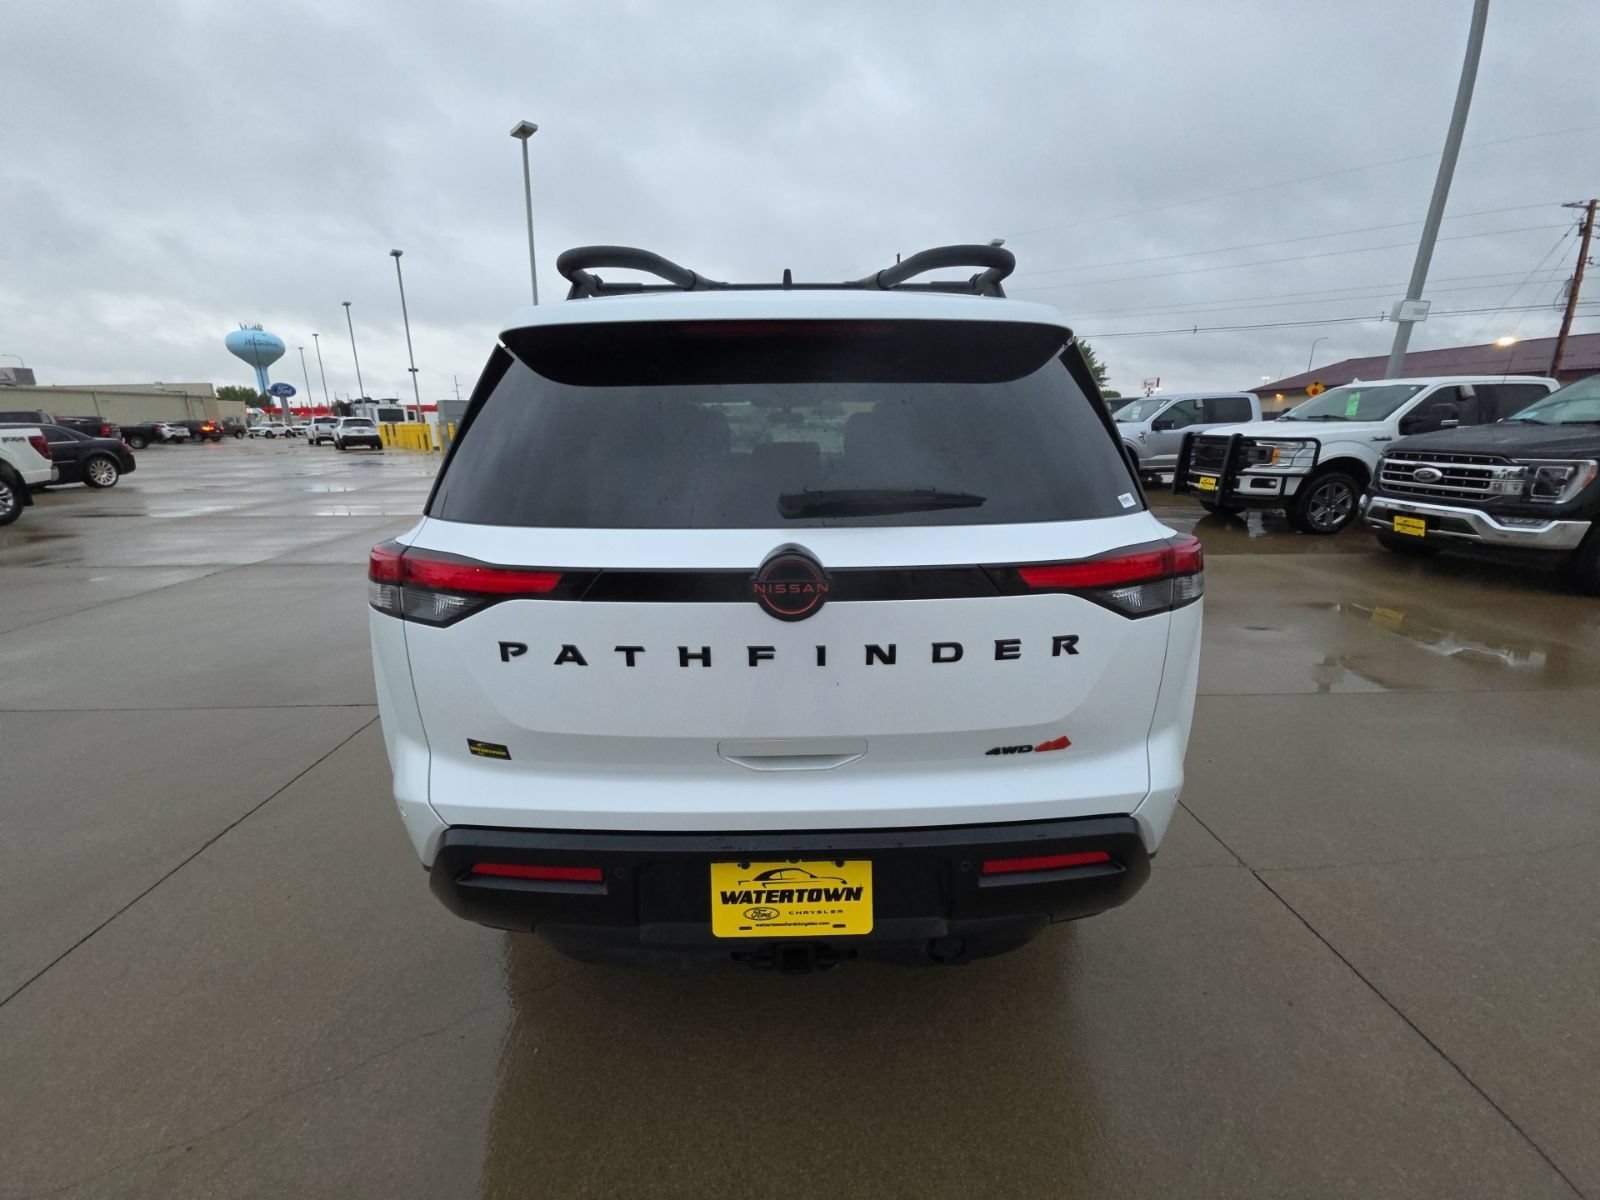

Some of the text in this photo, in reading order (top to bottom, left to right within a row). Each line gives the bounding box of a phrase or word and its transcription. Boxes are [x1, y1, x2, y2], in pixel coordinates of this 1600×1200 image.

[753, 582, 829, 594] NISSAN
[498, 634, 1080, 667] PATHFINDER
[985, 744, 1033, 756] 4WD
[720, 887, 864, 905] WATERTOWN
[748, 908, 775, 920] Ford
